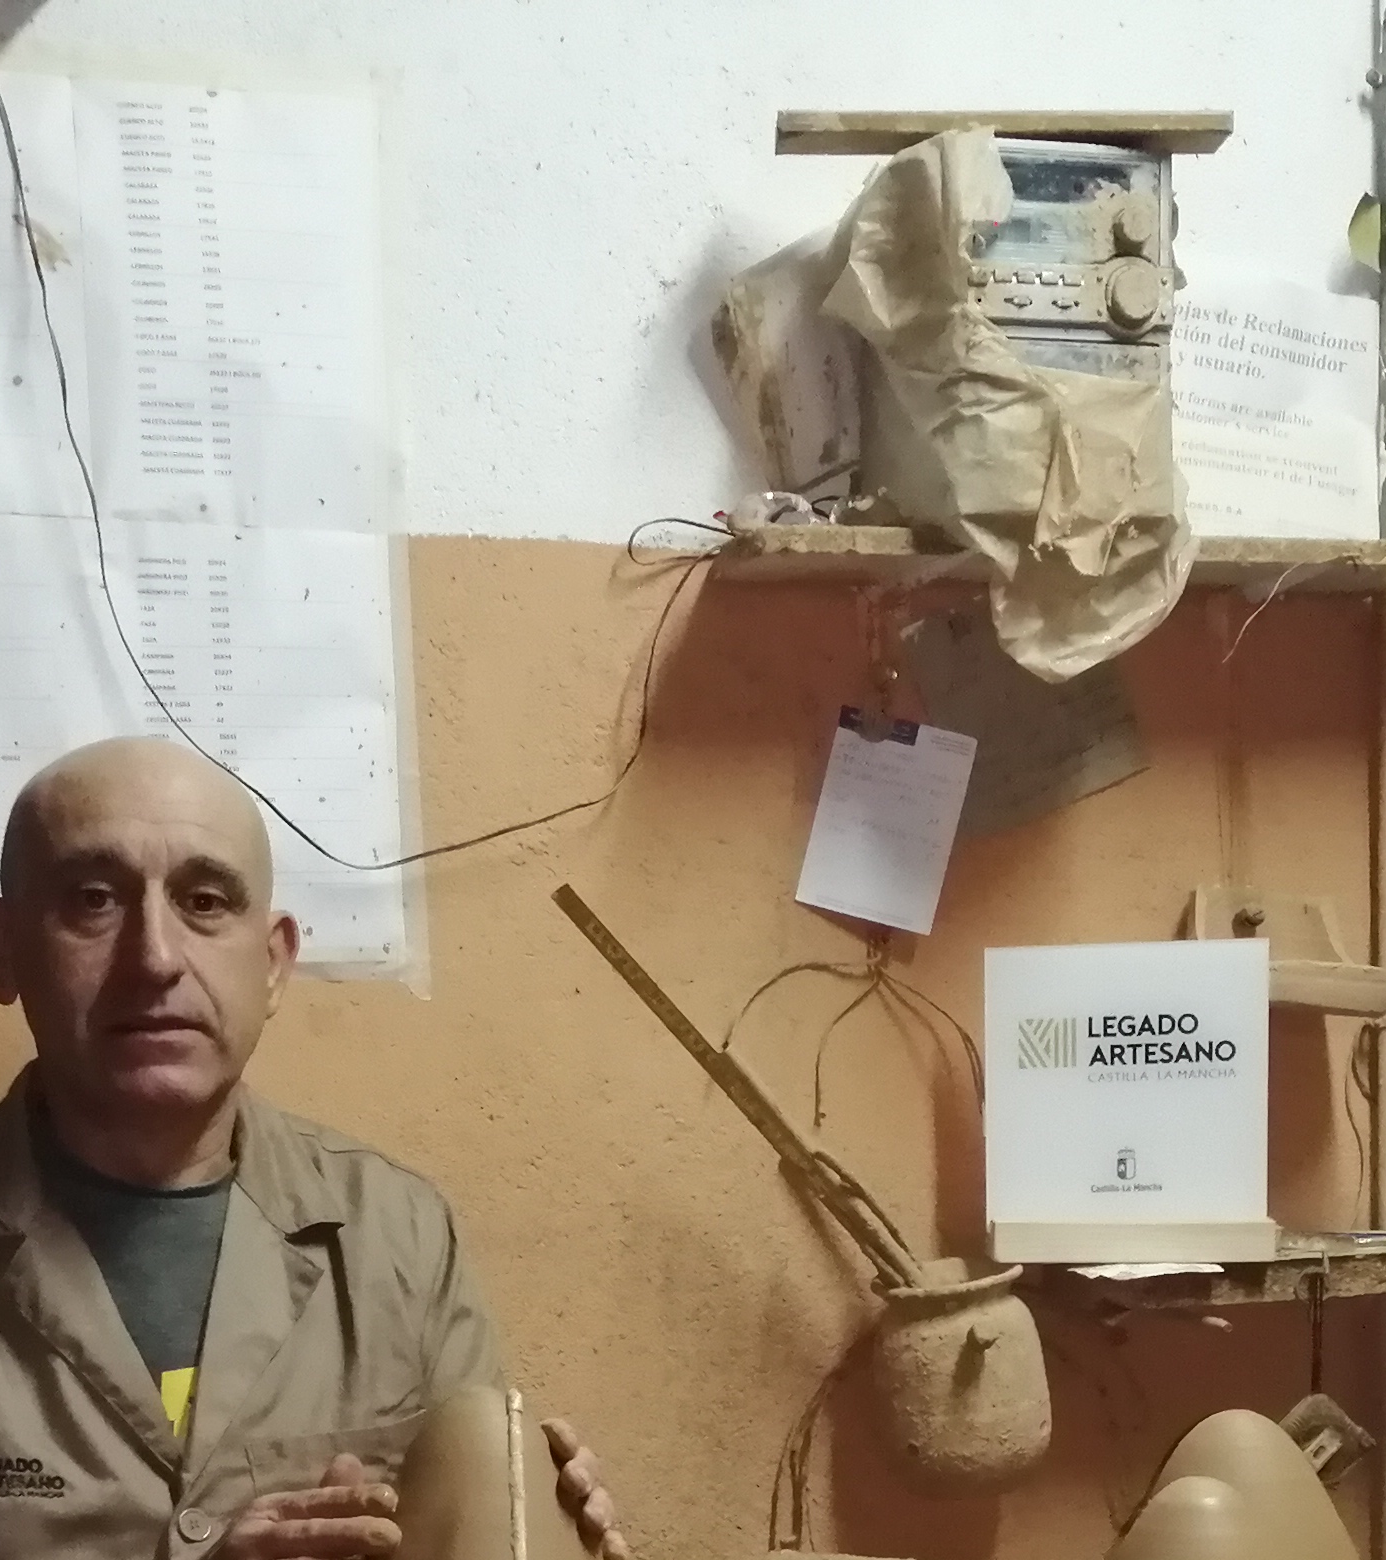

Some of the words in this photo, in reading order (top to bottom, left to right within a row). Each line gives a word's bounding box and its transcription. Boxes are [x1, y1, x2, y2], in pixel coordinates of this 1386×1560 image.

[1217, 309, 1238, 326] de
[1243, 313, 1369, 353] Reclamaciones
[1176, 351, 1188, 367] y
[1193, 354, 1266, 380] usuario.
[1217, 334, 1245, 352] del
[1251, 340, 1349, 374] consumidor
[1087, 1013, 1199, 1038] LEGADO
[1088, 1040, 1237, 1067] ARTESANO
